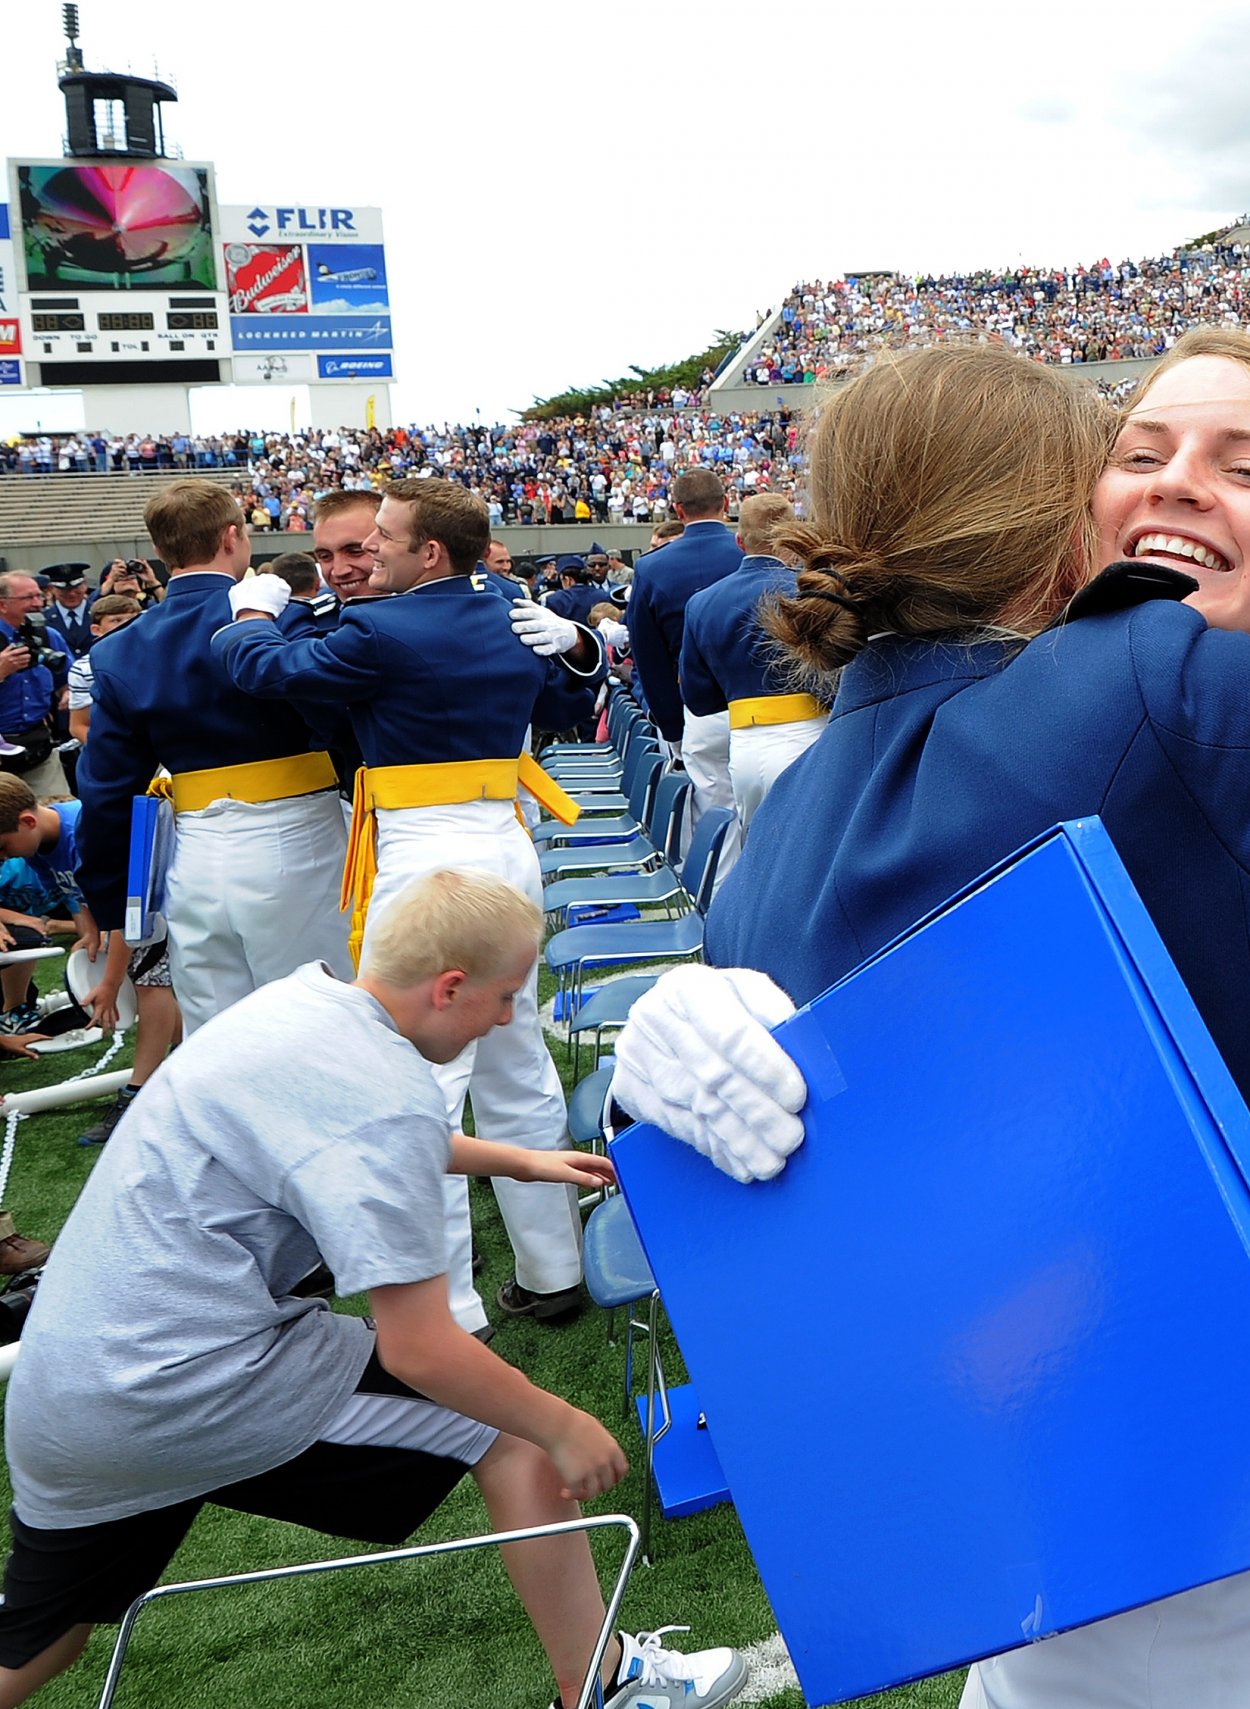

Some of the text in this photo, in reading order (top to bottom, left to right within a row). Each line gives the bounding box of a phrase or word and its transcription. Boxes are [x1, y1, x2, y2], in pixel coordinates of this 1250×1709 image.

[276, 208, 356, 230] FLIR
[228, 245, 301, 313] Budweiser
[238, 330, 363, 339] LOCKHEED MARTIN
[340, 361, 385, 369] BOEING
